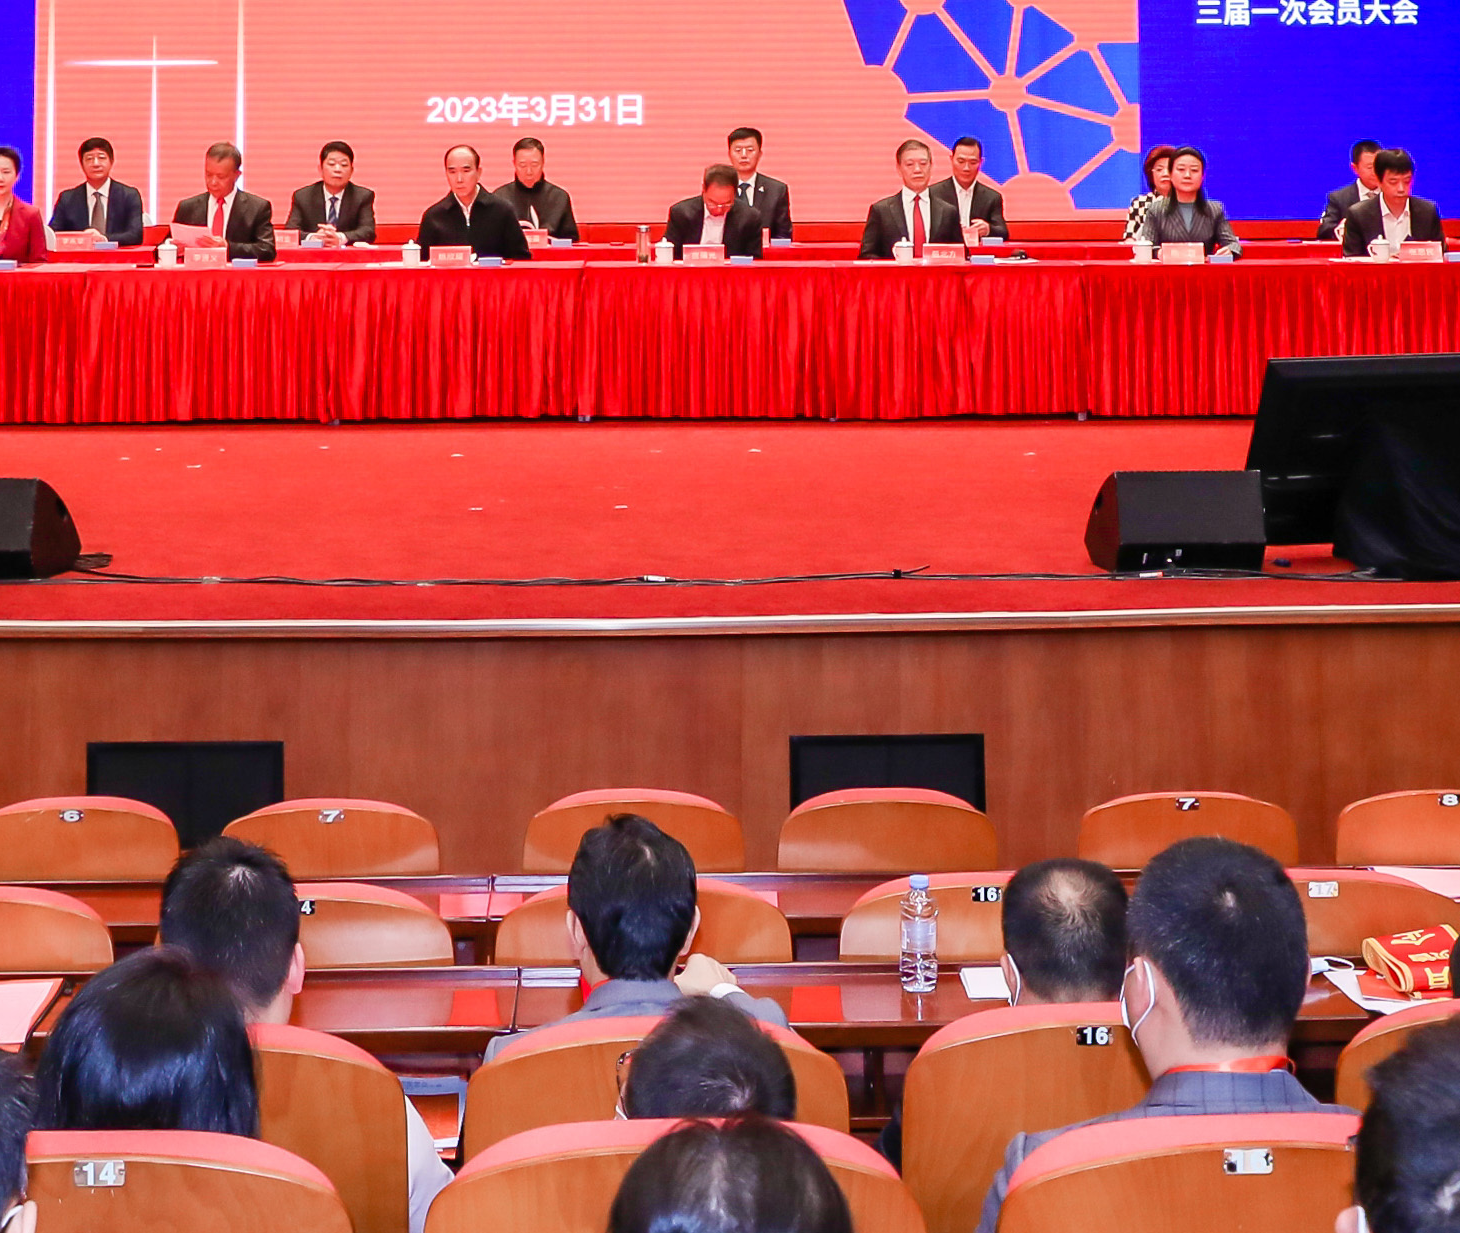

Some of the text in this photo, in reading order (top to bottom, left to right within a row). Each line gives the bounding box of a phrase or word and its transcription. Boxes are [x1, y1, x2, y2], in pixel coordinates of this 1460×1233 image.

[425, 92, 644, 127] 2023年3月31日
[1179, 798, 1196, 811] 7
[1442, 793, 1459, 806] 8
[63, 811, 80, 822] 6
[325, 809, 340, 823] 7
[978, 886, 998, 902] 16
[1316, 882, 1336, 897] 17
[300, 901, 313, 915] 4
[1082, 1026, 1108, 1045] 16
[81, 1161, 117, 1186] 14
